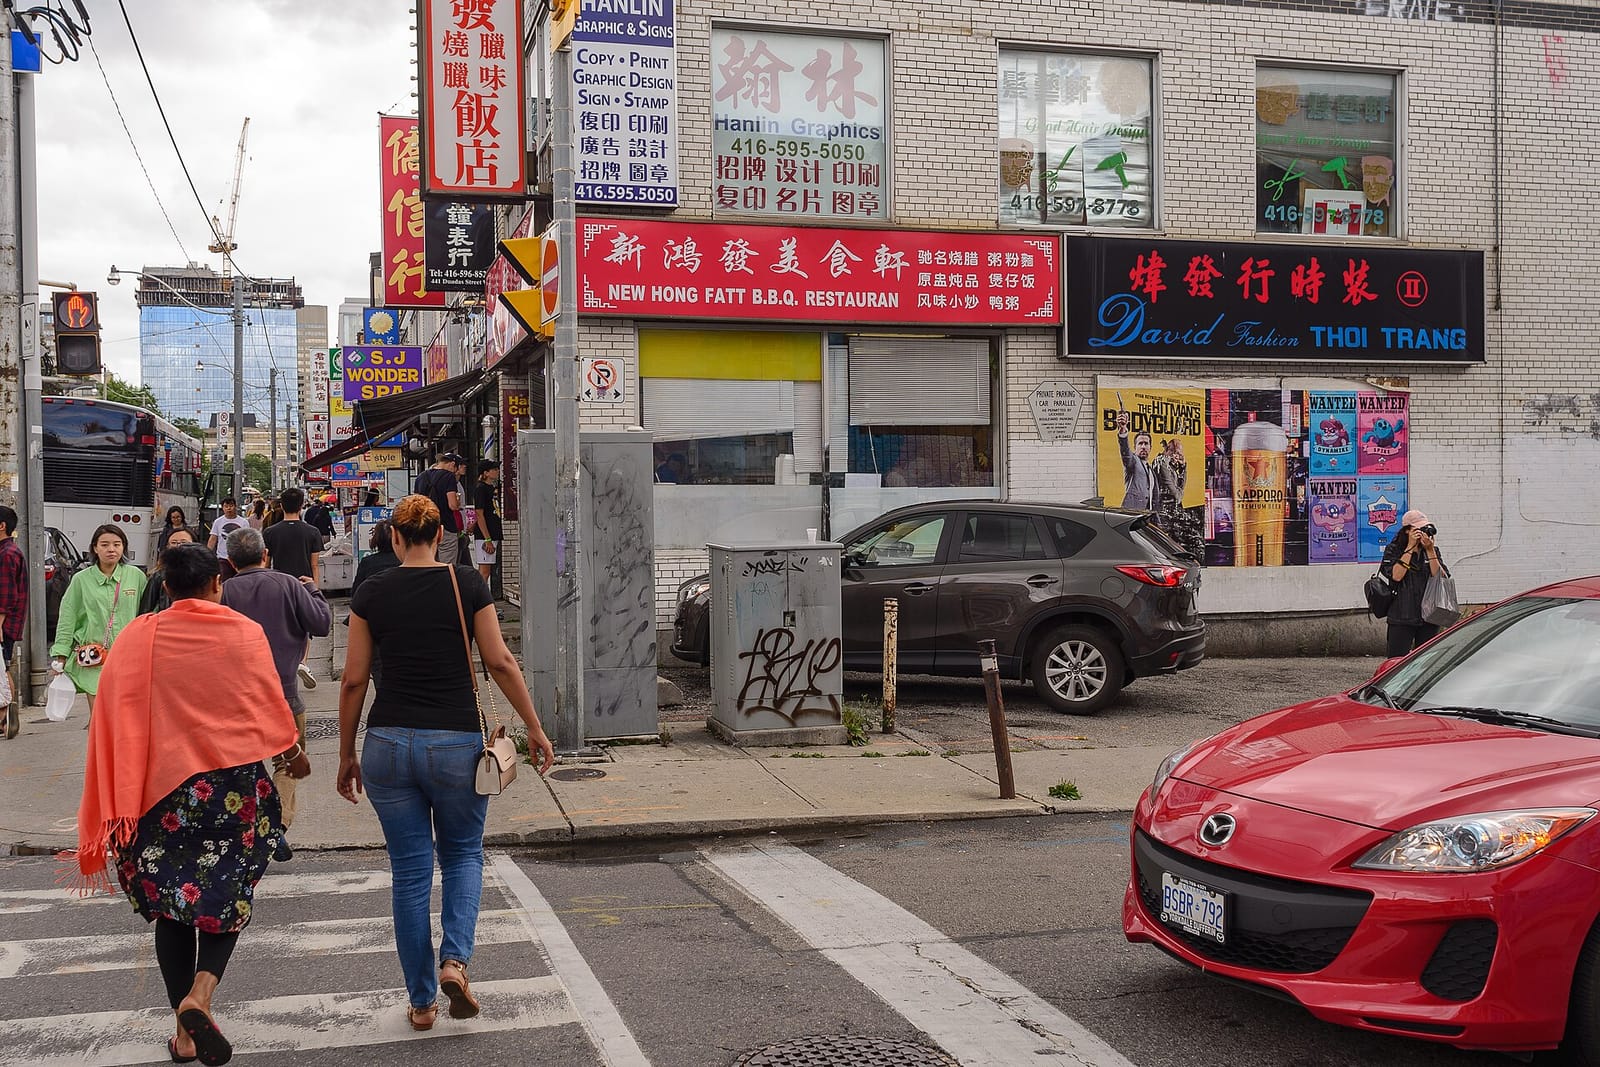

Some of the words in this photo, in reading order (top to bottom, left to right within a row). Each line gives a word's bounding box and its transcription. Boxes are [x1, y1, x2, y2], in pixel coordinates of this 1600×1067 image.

[581, 0, 664, 17] HANLIN
[574, 20, 624, 36] GRAPHIC
[627, 23, 637, 35] &
[639, 20, 674, 39] SIGNS
[577, 48, 615, 66] COPY
[630, 51, 669, 70] PRINT
[573, 68, 626, 88] GRAPHIC
[629, 70, 673, 90] DESIGN
[714, 35, 879, 119] 翰林
[578, 89, 611, 106] SIGN
[624, 91, 669, 110] STAMP
[628, 114, 668, 135] 印刷
[714, 113, 780, 134] Hanlin
[790, 118, 881, 141] Graphics
[1025, 117, 1061, 133] God
[451, 90, 500, 187] 飯店
[580, 136, 620, 156] 廣告
[628, 138, 668, 159] 設計
[731, 138, 865, 161] 416-595-5050
[580, 160, 621, 180] 招牌
[628, 163, 669, 183] 圖章
[715, 155, 767, 181] 招牌
[774, 158, 824, 185] 设计
[832, 161, 880, 188] 印刷
[575, 185, 674, 201] 416.595.5050
[715, 184, 767, 211] 复印
[776, 187, 824, 214] 名片
[832, 191, 880, 216] 图章
[1011, 193, 1140, 216] 416-597-8778
[917, 250, 979, 266] 驰名烧腊
[429, 269, 443, 277] Tel:
[988, 273, 1035, 289] 煲仔饭
[608, 283, 647, 303] NEW
[651, 285, 699, 304] HONG
[705, 286, 746, 305] FATT
[752, 288, 799, 307] B.B.Q.
[805, 290, 900, 309] RESTAURAN
[917, 293, 979, 309] 风味小炒
[989, 295, 1019, 310] 鸭粥
[1087, 293, 1224, 347] David
[1226, 321, 1301, 348] Fashion
[1309, 325, 1368, 348] THOI
[1381, 327, 1467, 351] TRANG
[371, 350, 405, 365] S.J
[346, 367, 419, 382] WONDER
[361, 384, 404, 400] SPA
[509, 395, 529, 405] Ha
[1036, 390, 1054, 398] PRIVATE
[1056, 390, 1075, 398] PARKING
[1137, 403, 1152, 413] THE
[1152, 400, 1201, 419] HITMAN'S
[1310, 397, 1356, 410] WANTED
[1359, 397, 1405, 410] WANTED
[364, 452, 372, 462] E
[374, 452, 396, 463] style
[1237, 489, 1283, 503] SAPPORO
[1310, 481, 1357, 495] WANTED
[1164, 885, 1193, 918] BSBR
[1202, 898, 1222, 929] 792
